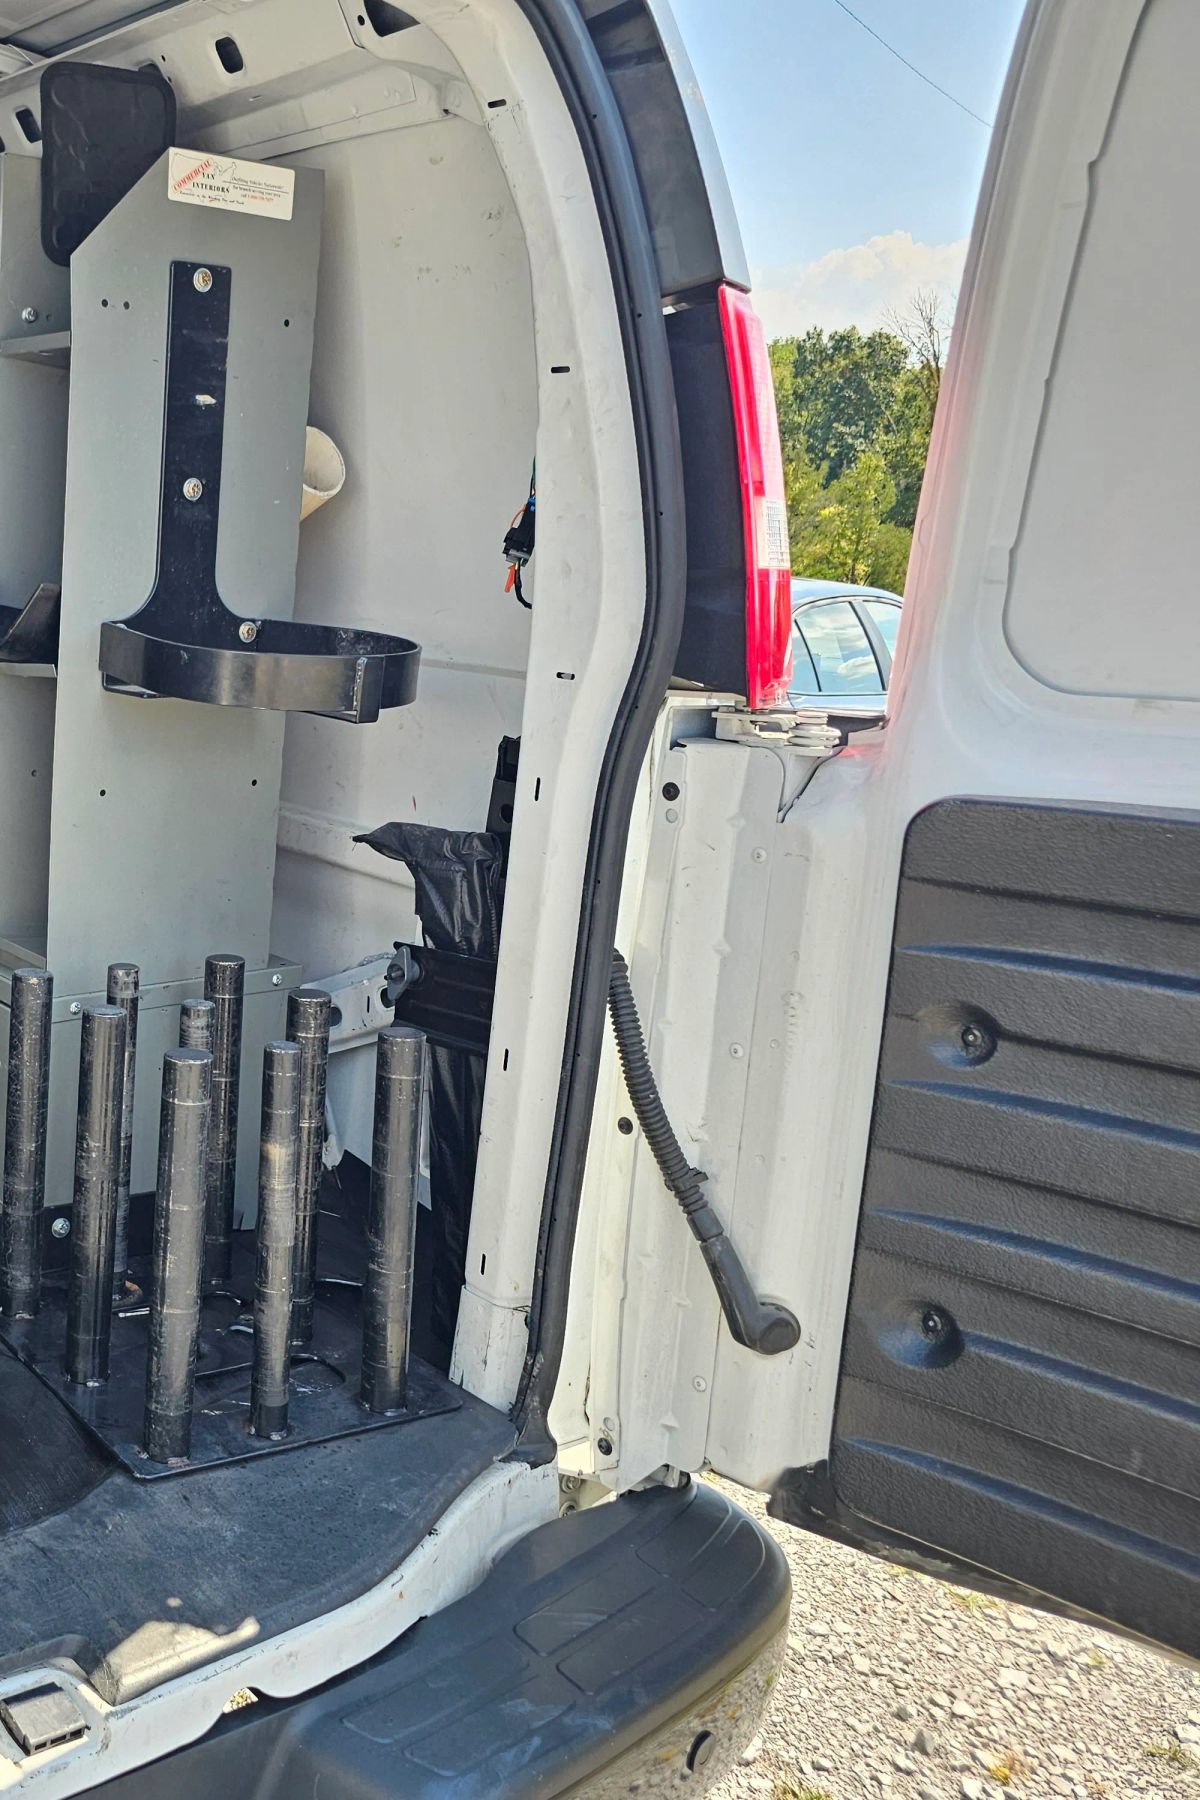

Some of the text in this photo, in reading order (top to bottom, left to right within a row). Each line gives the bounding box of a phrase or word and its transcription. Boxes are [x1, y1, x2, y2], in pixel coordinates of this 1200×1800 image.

[173, 159, 212, 191] COMMERCIAL
[202, 172, 215, 180] VAN
[192, 181, 230, 194] INTERIORS
